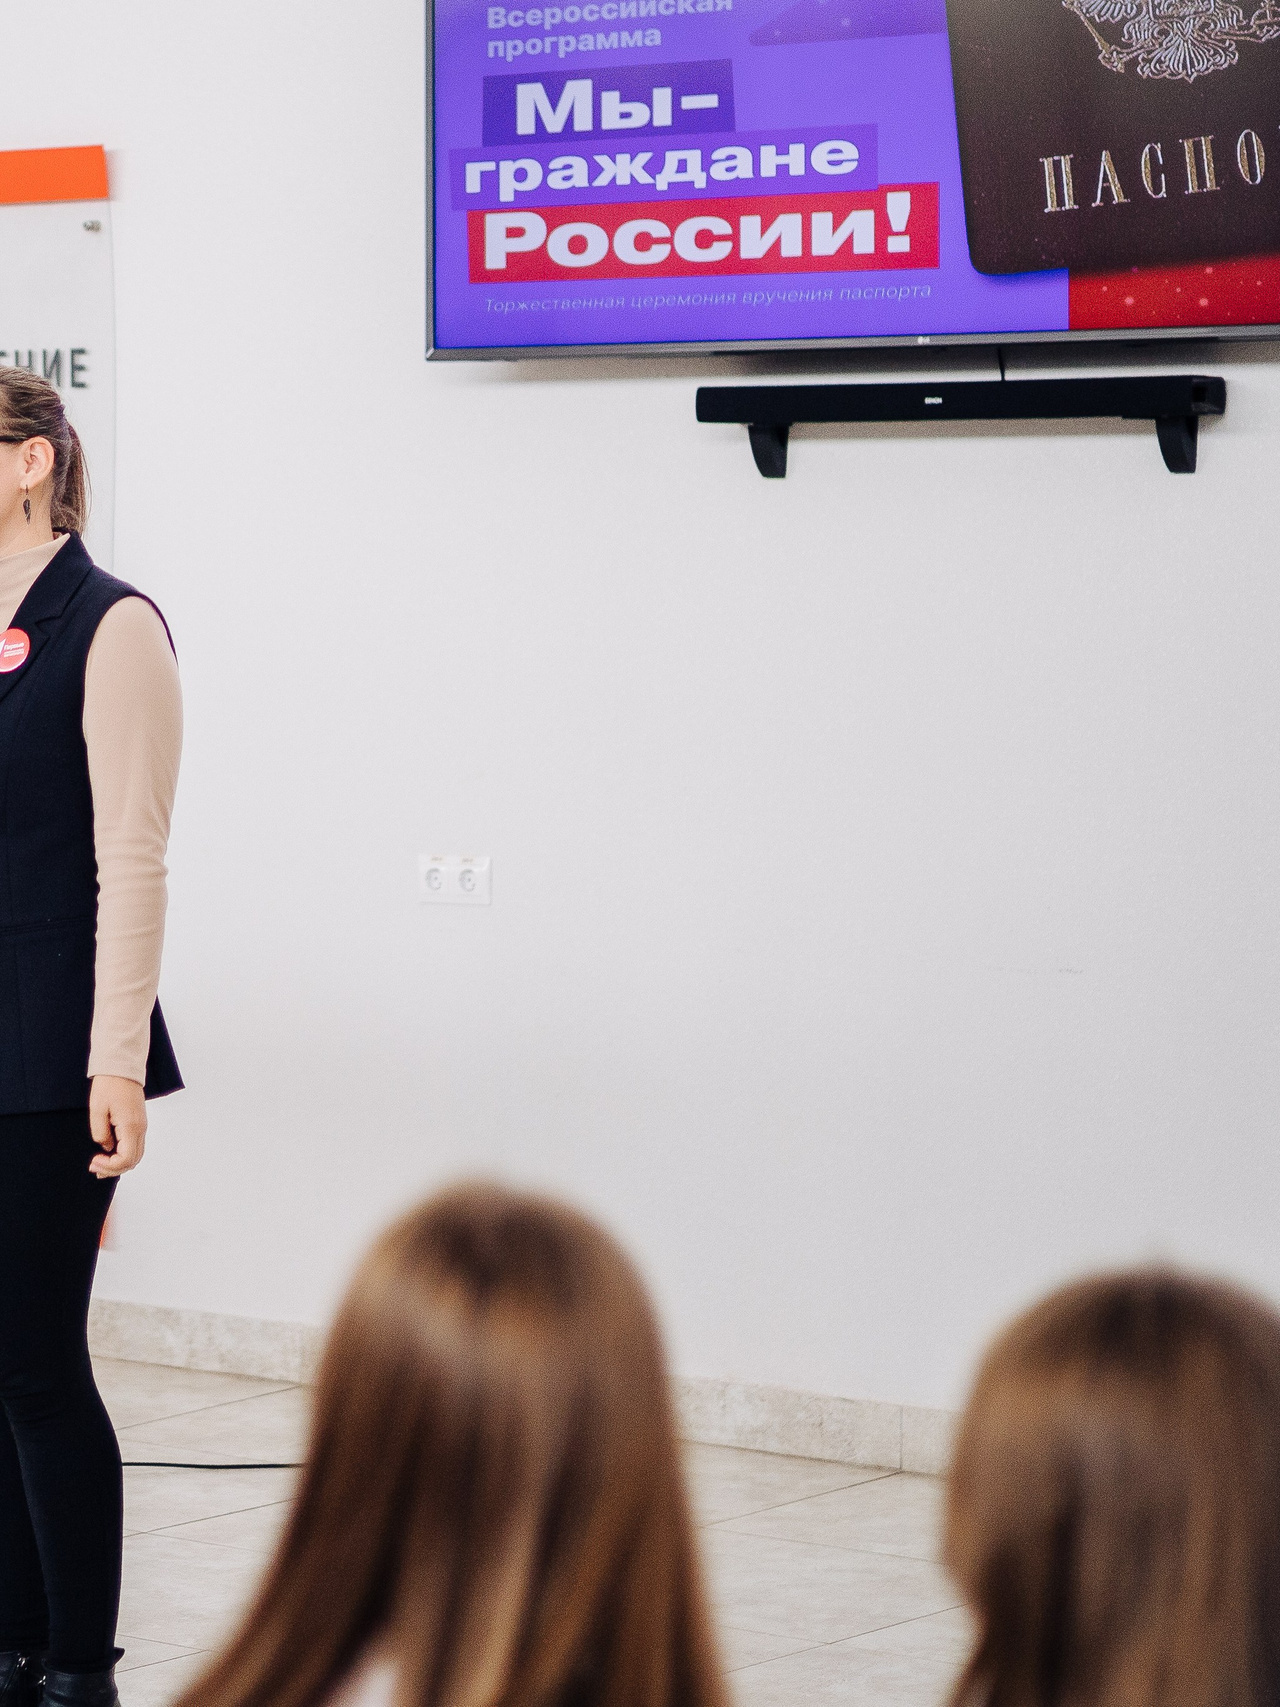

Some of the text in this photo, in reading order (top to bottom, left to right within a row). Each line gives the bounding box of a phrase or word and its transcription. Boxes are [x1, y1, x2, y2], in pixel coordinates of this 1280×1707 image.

[487, 28, 662, 62] программа
[465, 139, 860, 202] граждане
[1039, 128, 1280, 213] ПАСПО
[483, 190, 912, 270] России!
[486, 284, 932, 314] Торжественная церемония вручения паспорта
